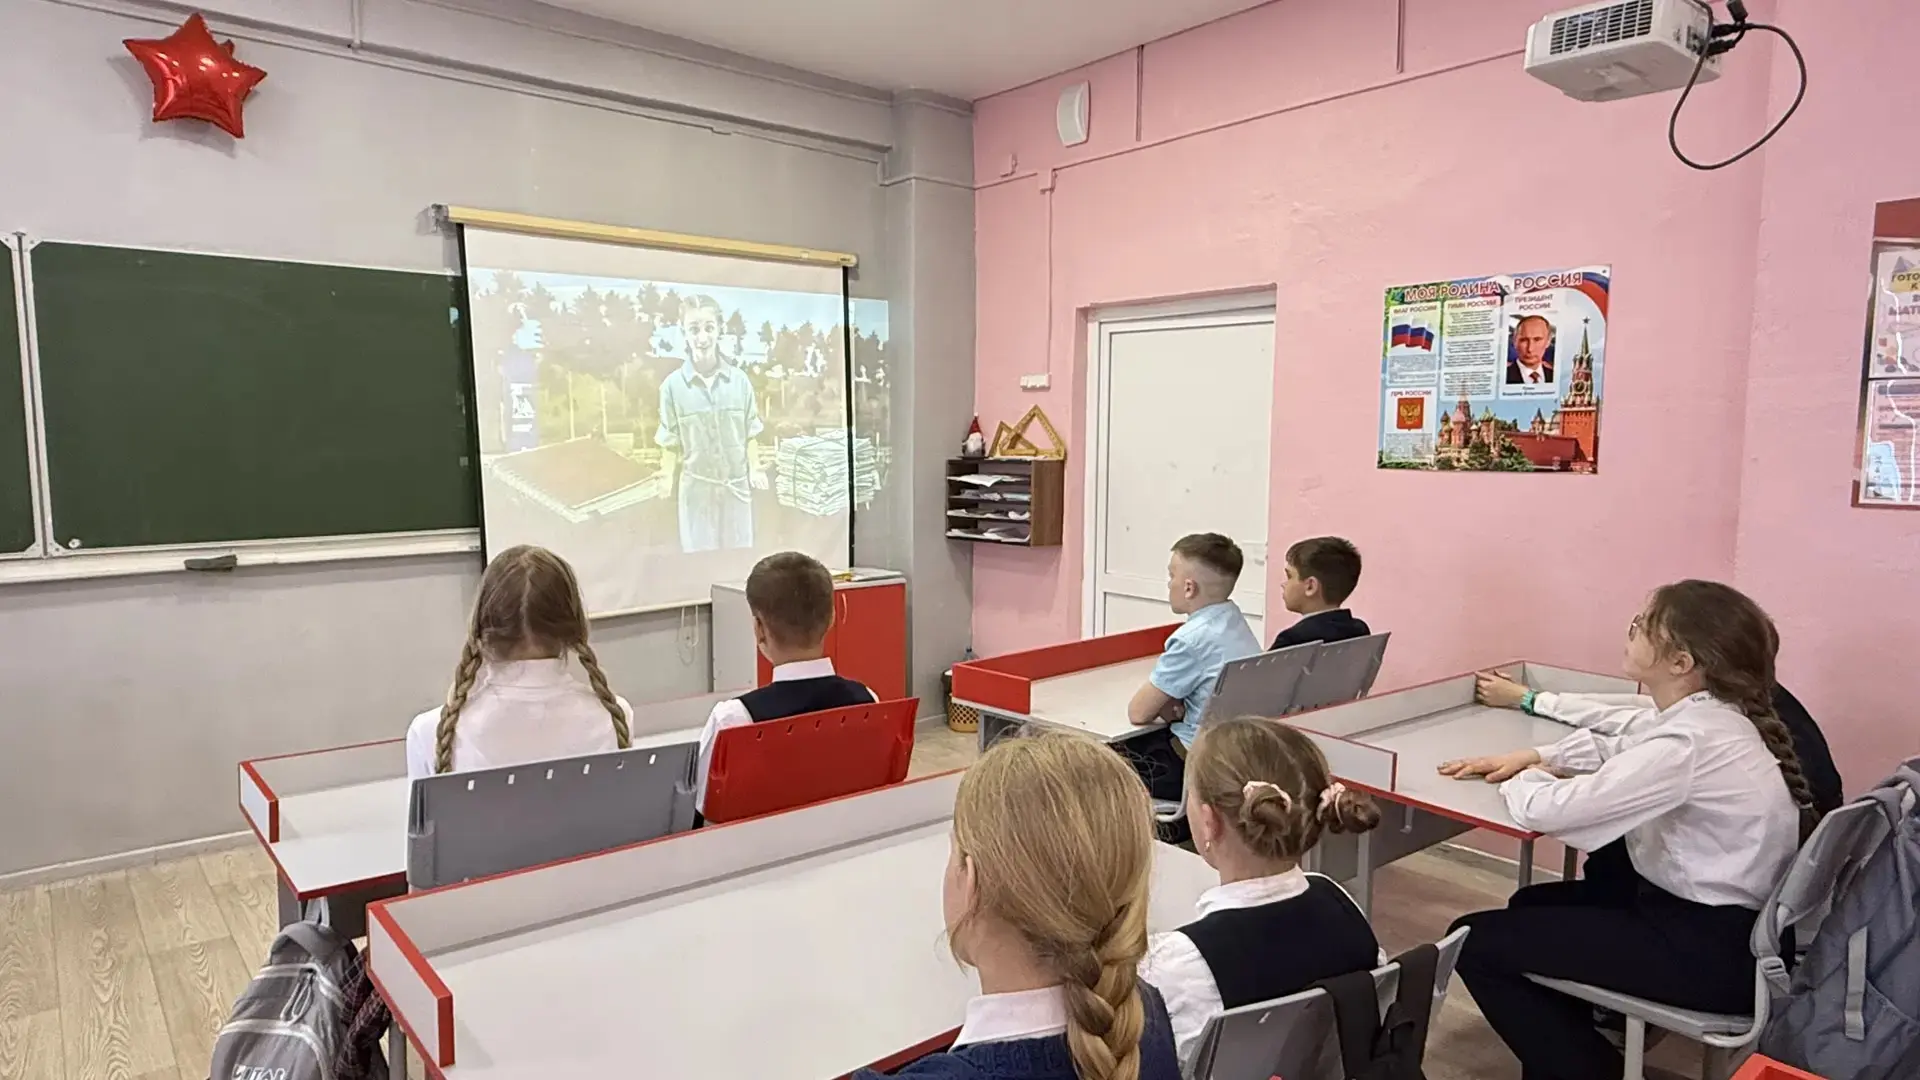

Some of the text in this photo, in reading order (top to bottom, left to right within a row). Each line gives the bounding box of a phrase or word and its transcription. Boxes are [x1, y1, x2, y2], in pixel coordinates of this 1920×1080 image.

[1405, 286, 1437, 301] МОЯ
[1440, 281, 1500, 297] РОДИНА
[1513, 272, 1583, 291] РОССИЯ
[1515, 294, 1553, 303] ПРЕЗИДЕНТ
[1410, 304, 1437, 312] РОССИИ
[1467, 299, 1497, 308] РОССИИ
[1518, 303, 1551, 311] РОССИИ
